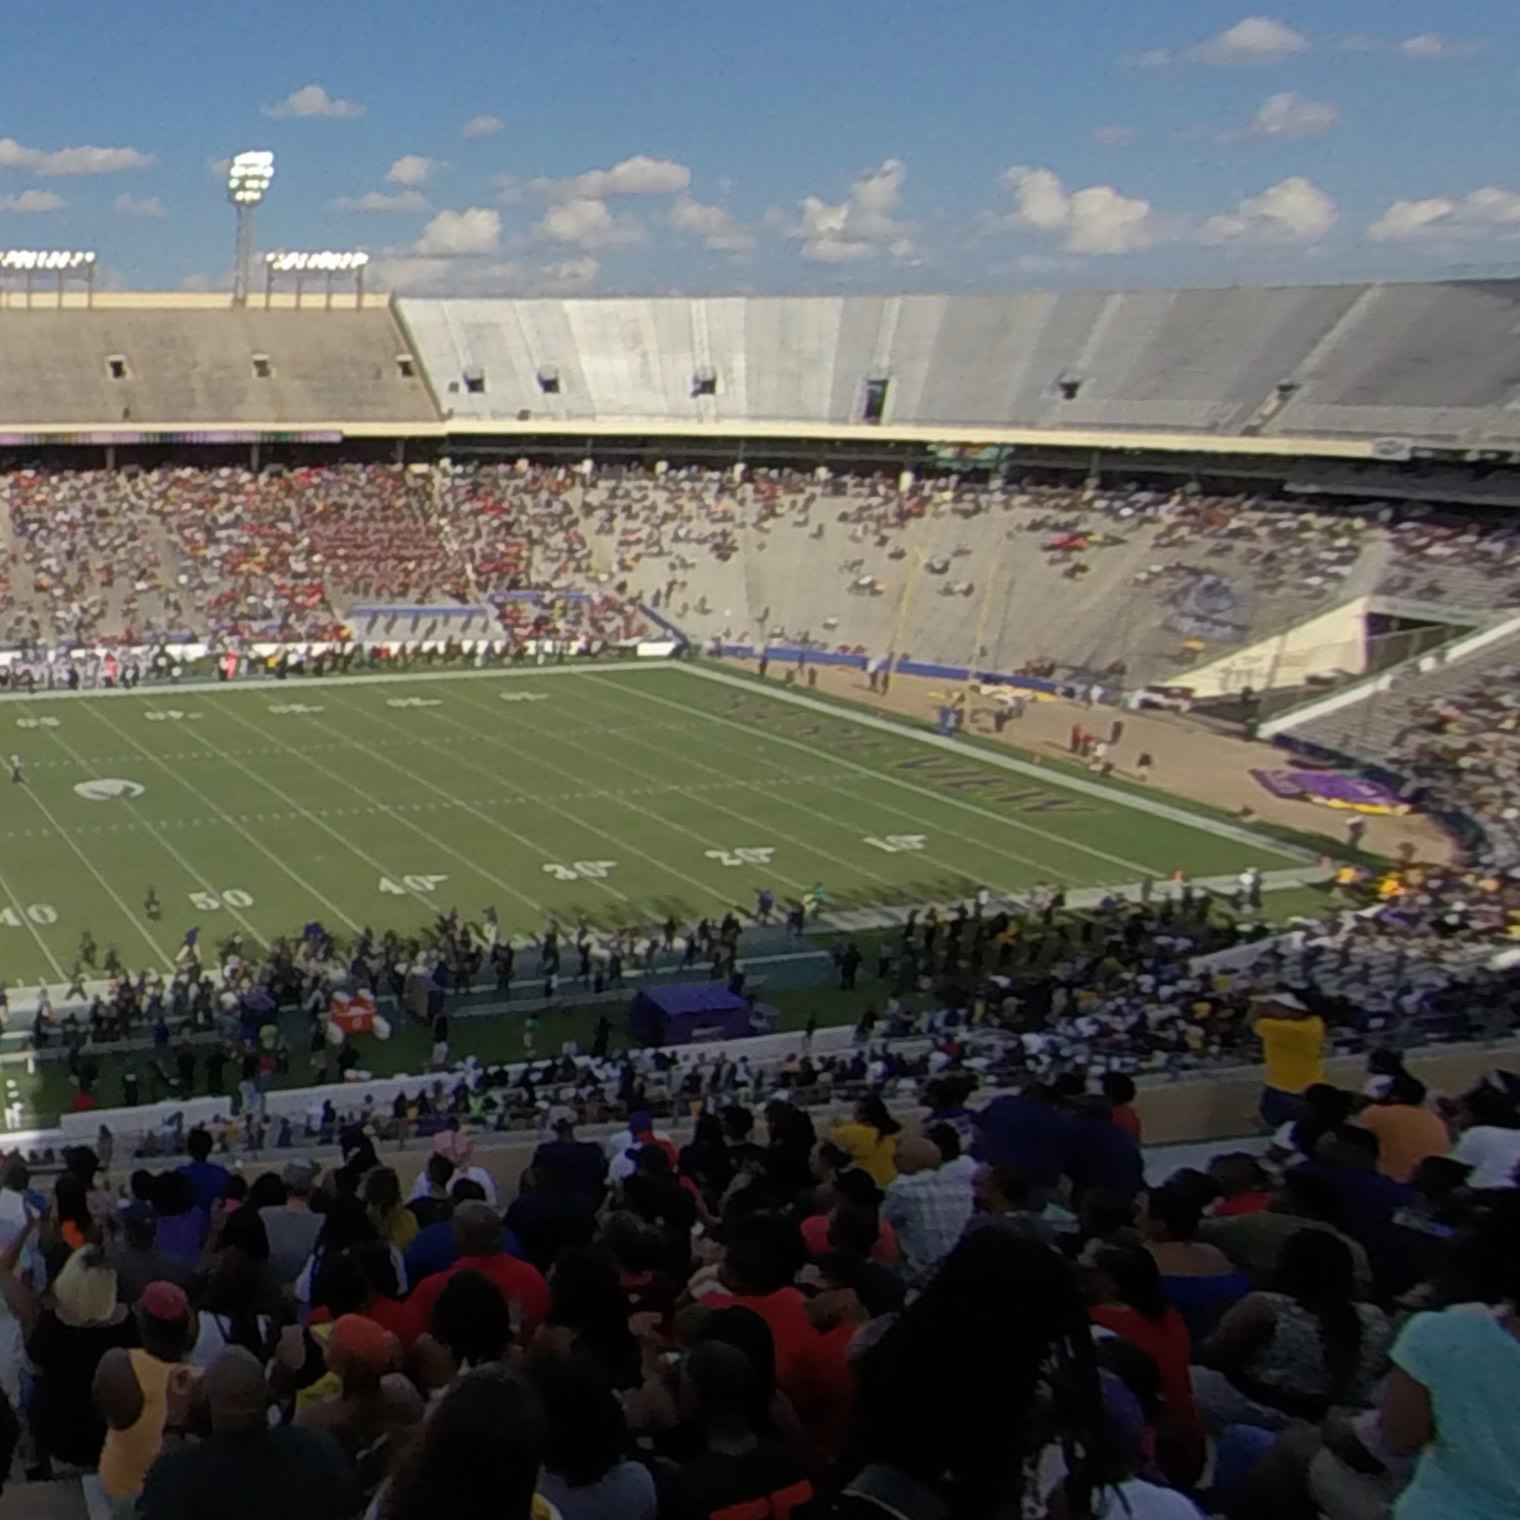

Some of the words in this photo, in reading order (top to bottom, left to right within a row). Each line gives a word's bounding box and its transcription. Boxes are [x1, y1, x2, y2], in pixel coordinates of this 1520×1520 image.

[705, 848, 771, 866] 20
[542, 861, 609, 880] 30
[379, 875, 436, 895] 40
[187, 889, 255, 911] 50
